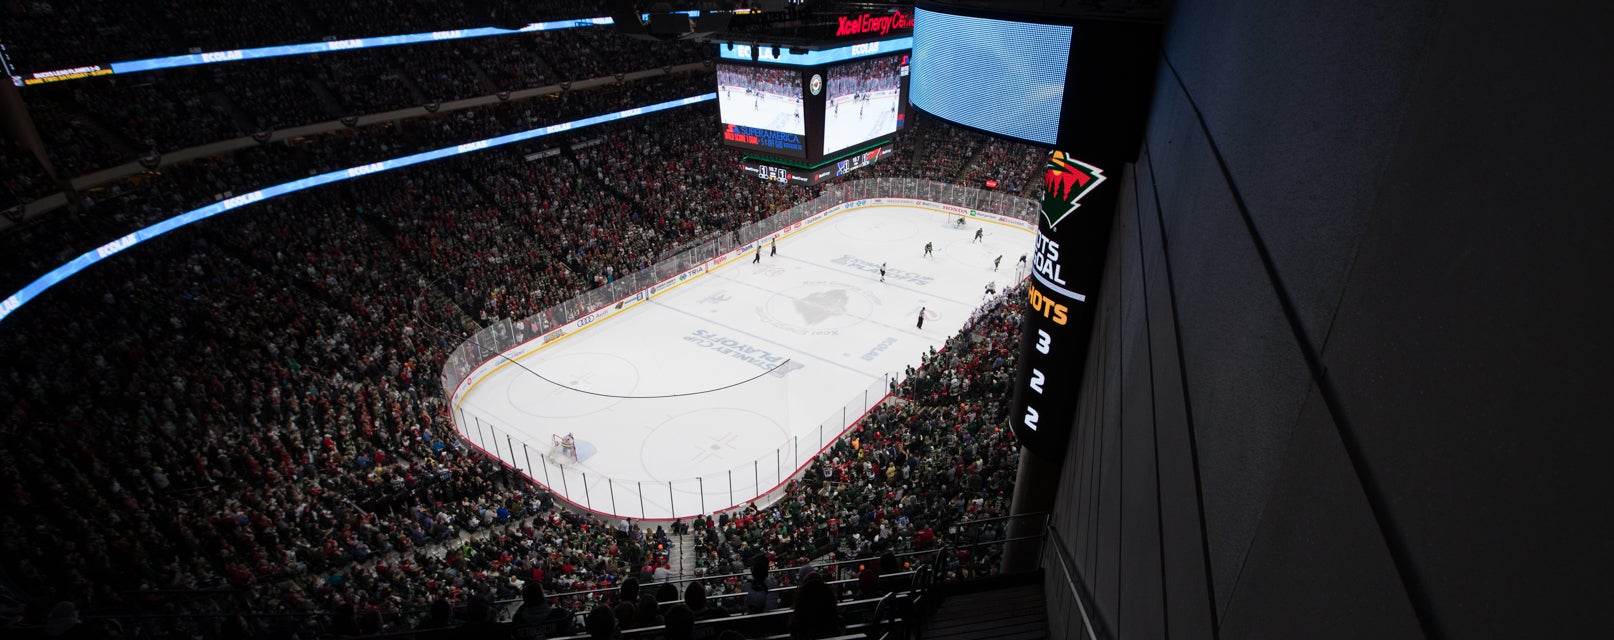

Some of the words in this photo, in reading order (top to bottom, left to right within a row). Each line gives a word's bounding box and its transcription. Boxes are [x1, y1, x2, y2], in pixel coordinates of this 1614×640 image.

[836, 15, 862, 36] Xcel
[862, 13, 892, 36] Energy
[201, 49, 243, 63] ECOLAB
[741, 126, 800, 143] SUPERAMERICA
[457, 140, 488, 153] ECOLAB
[348, 162, 384, 178] ECOLAB
[223, 190, 263, 210] ECOLAB
[943, 205, 968, 215] HONDA
[97, 232, 137, 259] ECOLAB
[688, 266, 703, 276] TRIA
[683, 335, 715, 348] CUP
[692, 329, 784, 363] PLAYOFFS
[1035, 329, 1052, 355] 3
[1029, 368, 1046, 394] 2
[1023, 406, 1040, 431] 2
